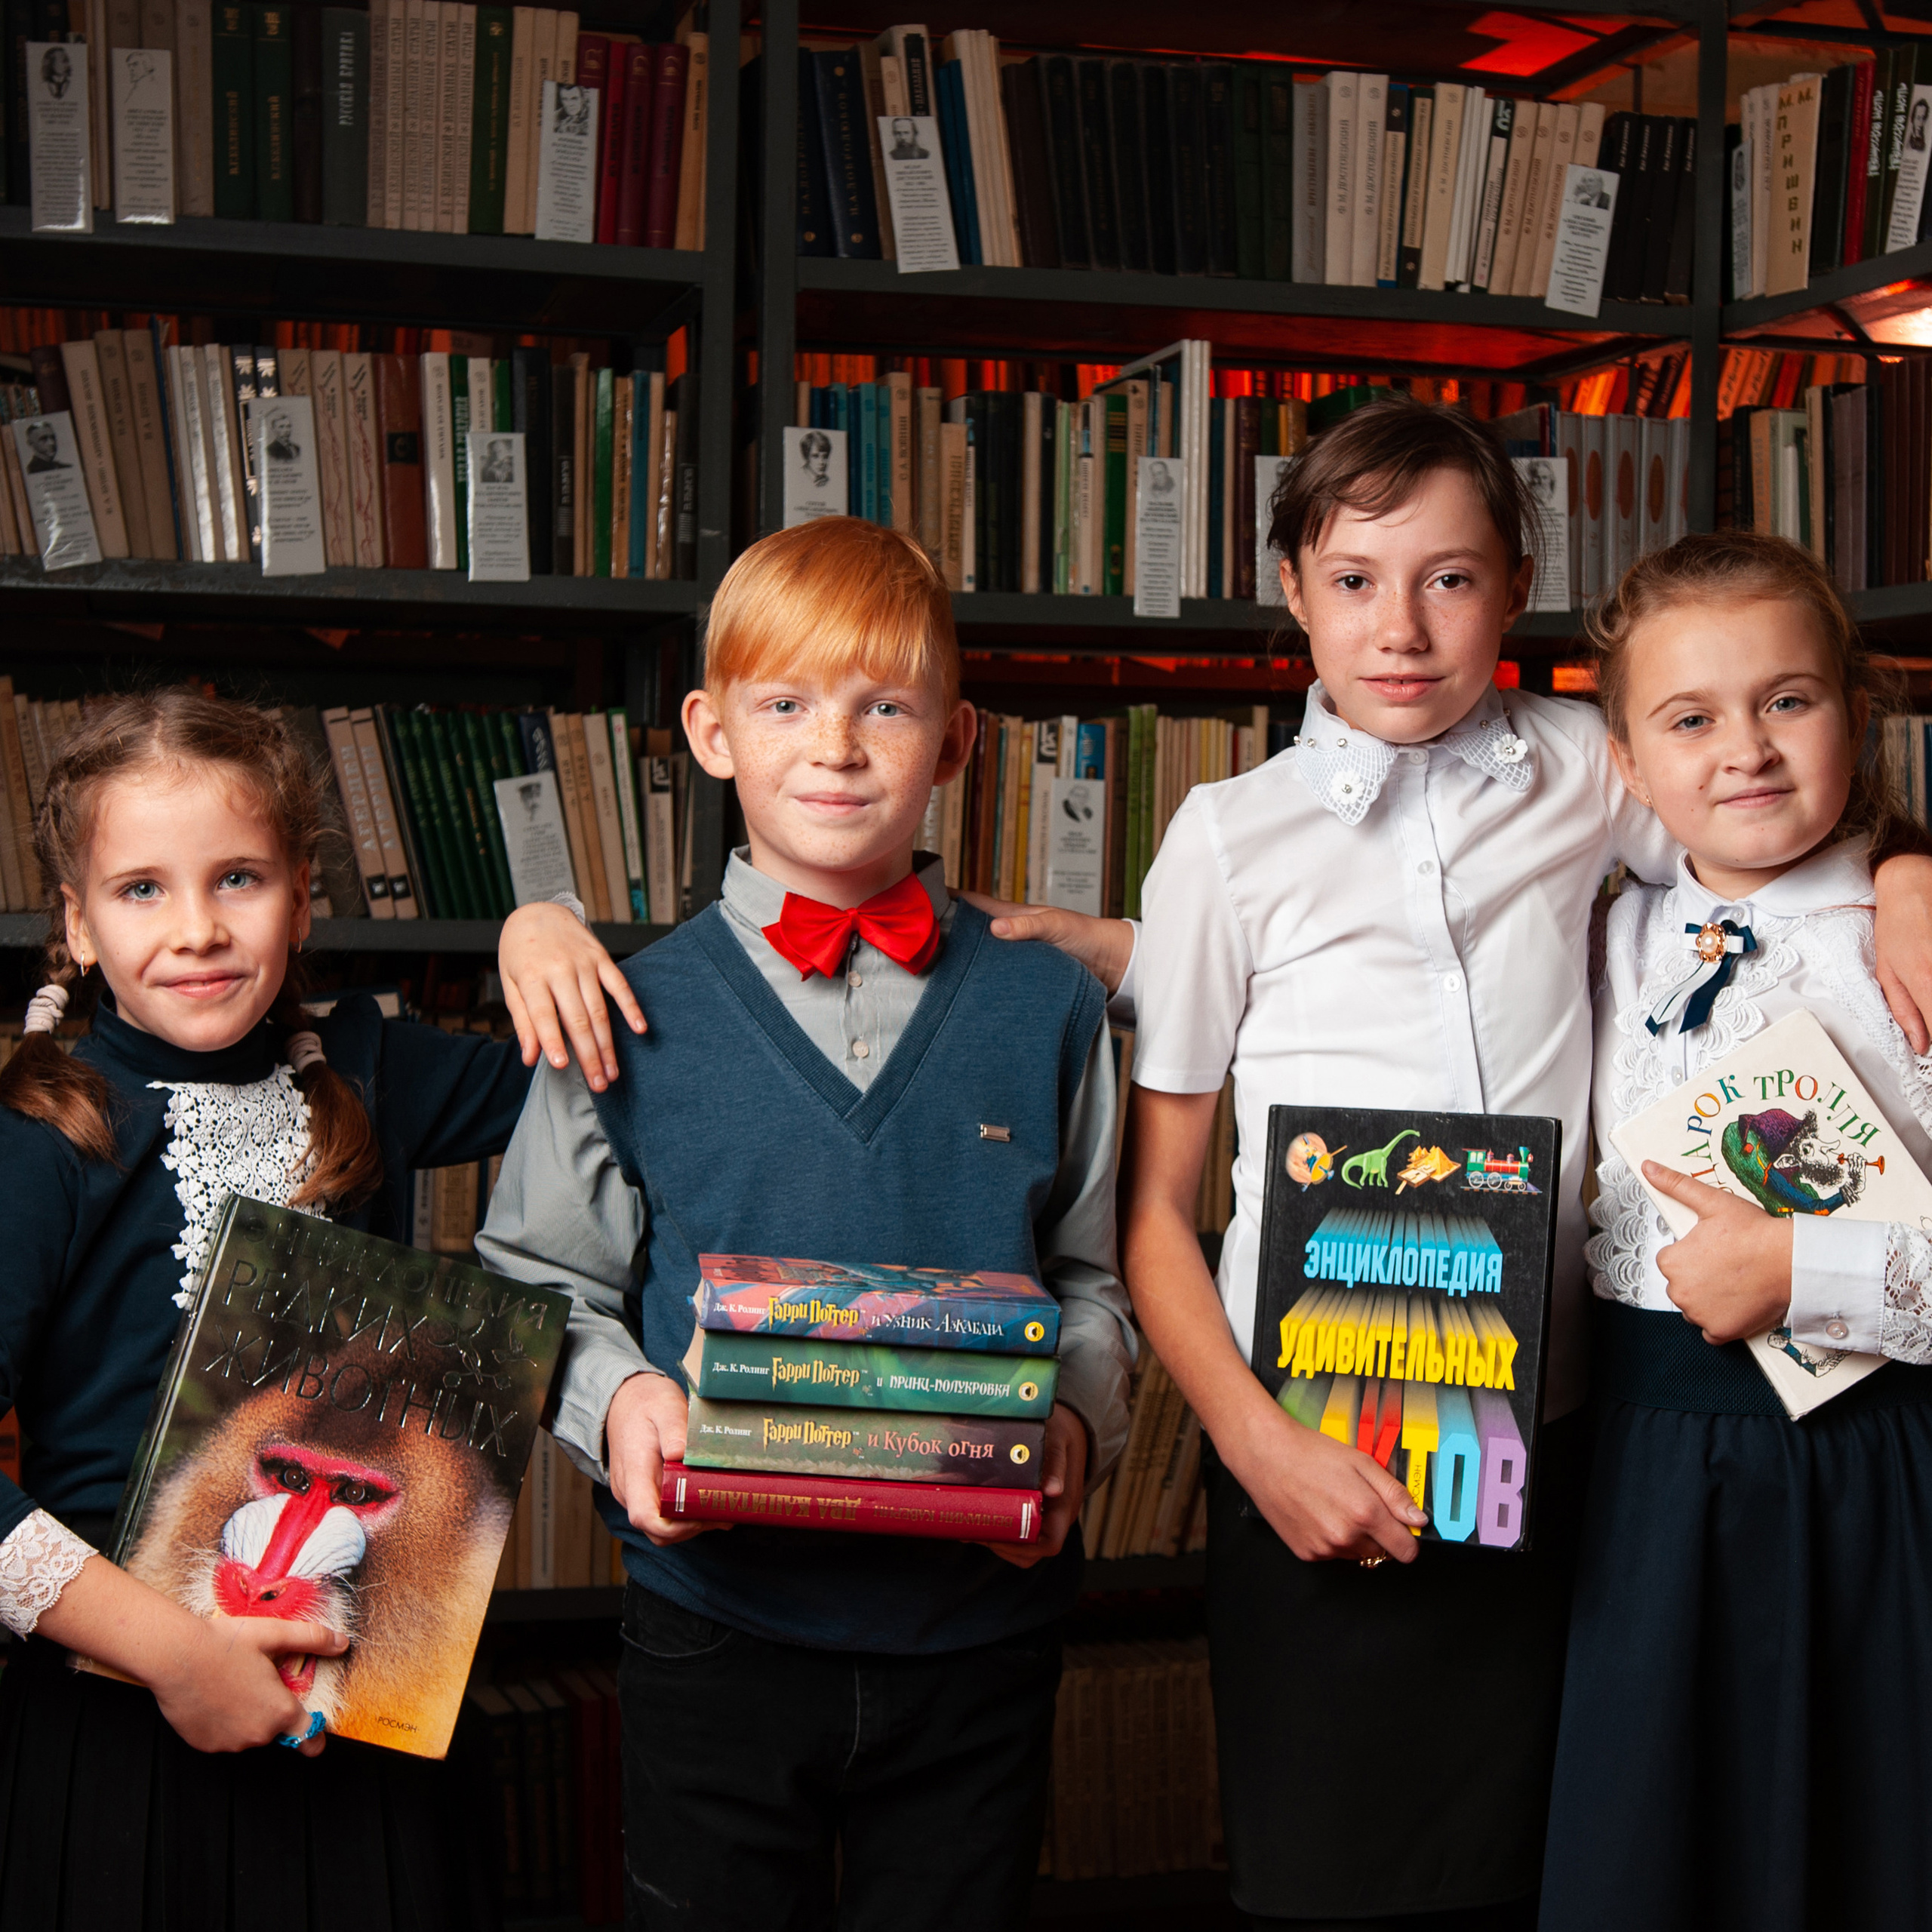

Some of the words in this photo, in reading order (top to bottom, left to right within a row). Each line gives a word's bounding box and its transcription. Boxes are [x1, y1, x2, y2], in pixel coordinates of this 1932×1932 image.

[338, 31, 355, 77] КРИТИКА
[337, 84, 355, 126] РУССКАЯ
[1338, 119, 1349, 192] ДОСТОЕВСКИЙ
[1365, 121, 1377, 192] ДОСТОЕВСКИЙ
[1776, 115, 1803, 255] ПРИШВИН
[1681, 1074, 1744, 1194] ДАРОК
[1753, 1069, 1881, 1149] ТРОЛЛЯ
[242, 1215, 549, 1331] ЭНЦИКЛОПЕДИЯ
[1303, 1239, 1503, 1297] ЭНЦИКЛОПЕДИЯ
[221, 1259, 428, 1361] РЕДКИХ
[713, 1303, 728, 1312] Дж.
[729, 1304, 737, 1313] К.
[738, 1305, 766, 1315] Ролинг
[768, 1297, 808, 1331] Гарри
[809, 1300, 860, 1327] Поттер
[871, 1314, 881, 1327] и
[712, 1362, 728, 1373] Дж.
[730, 1363, 739, 1373] К.
[740, 1363, 770, 1376] Ролинг
[771, 1357, 811, 1389] Гарри
[812, 1359, 860, 1387] Поттер
[877, 1377, 883, 1387] и
[889, 1375, 1011, 1398] ПРИНЦ-ПОЛУКРОВКА
[1277, 1320, 1518, 1390] УДИВИТЕЛЬНЫХ
[200, 1324, 518, 1458] ЖИВОТНЫХ
[700, 1423, 714, 1434] Дж.
[715, 1426, 723, 1435] К.
[724, 1426, 752, 1437] Ролинг
[763, 1417, 801, 1450] Гарри
[803, 1423, 852, 1448] Поттер
[868, 1434, 878, 1447] и
[884, 1431, 942, 1457] Кубок
[949, 1442, 995, 1459] огня
[698, 1488, 811, 1518] КАПИТАНА
[1320, 1415, 1527, 1548] ТОВ
[1412, 1464, 1422, 1506] ОСМЭН
[816, 1496, 861, 1521] ДВА
[873, 1504, 933, 1522] КАВЕРИН
[938, 1508, 1014, 1528] ВЕНИАМИН
[377, 1716, 418, 1734] РОСМЭН
